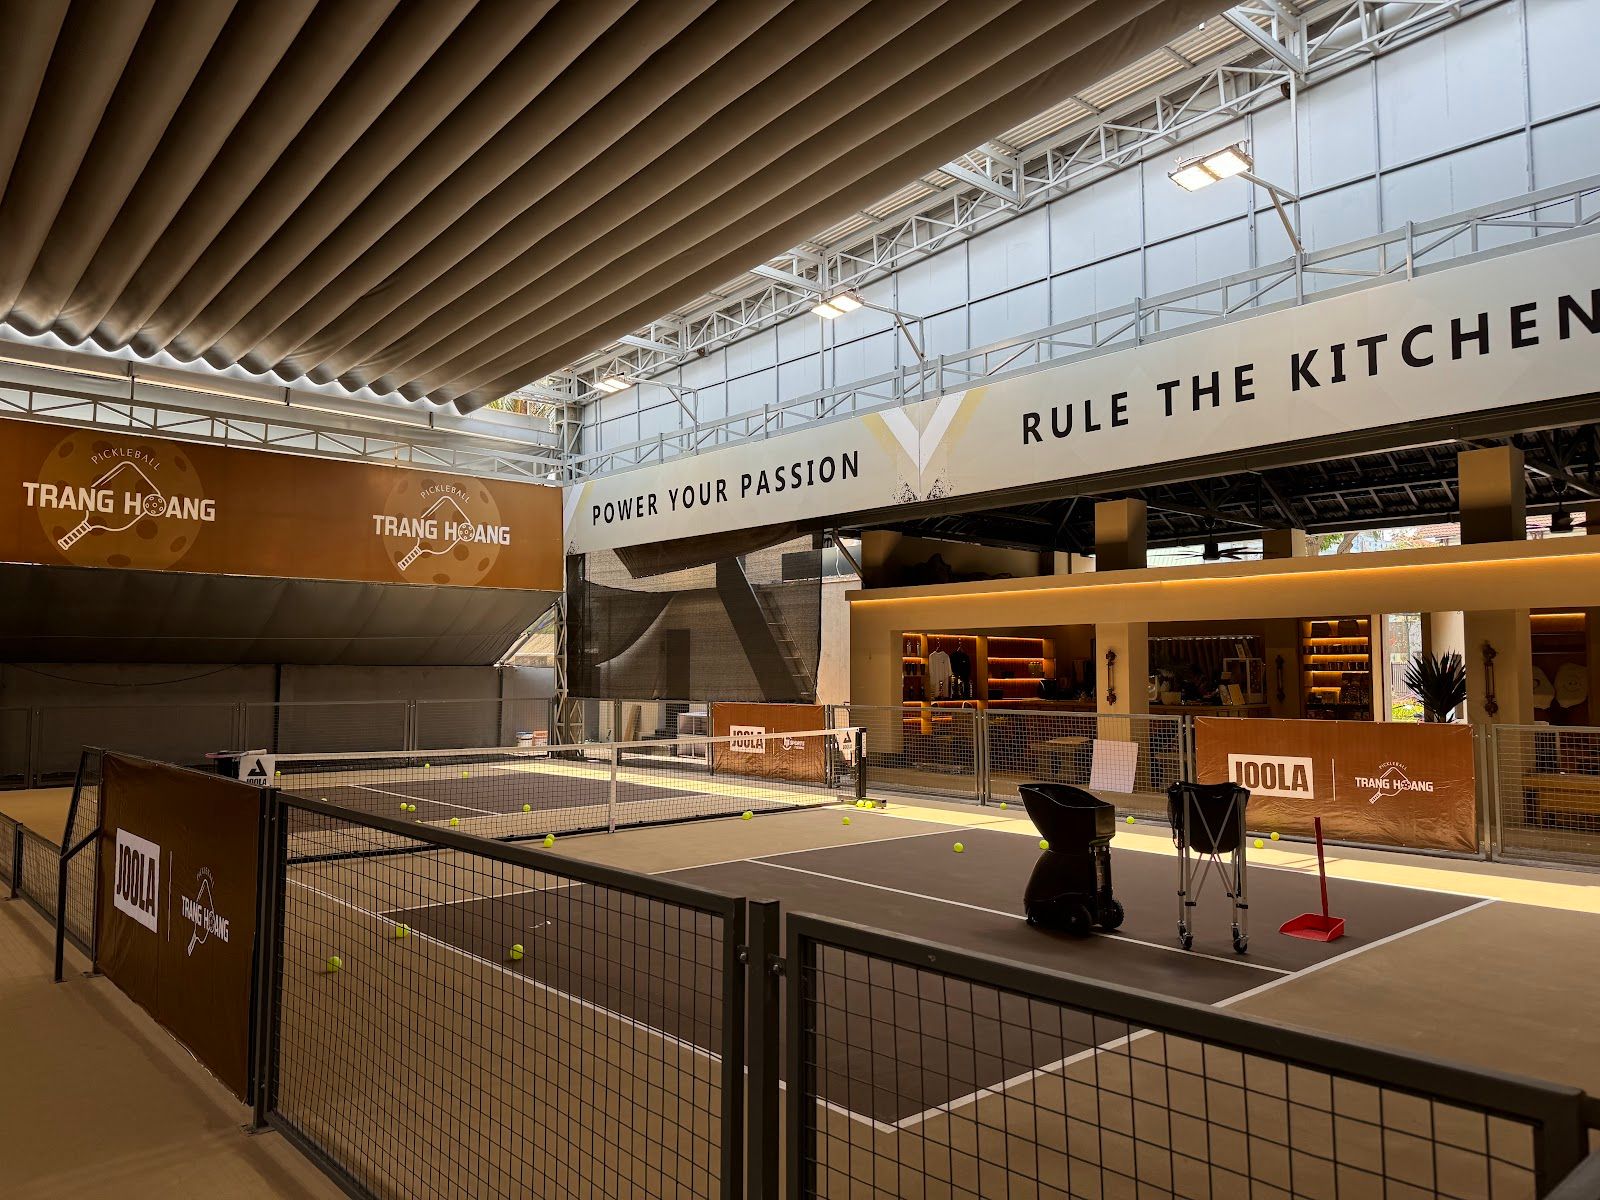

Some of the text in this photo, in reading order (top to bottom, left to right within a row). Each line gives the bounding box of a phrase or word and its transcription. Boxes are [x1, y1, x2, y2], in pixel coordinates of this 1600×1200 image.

[1023, 288, 1600, 445] RULE THE KITCHEN
[91, 447, 160, 471] PICKLEBALL
[22, 481, 216, 522] TRANG HOANG
[420, 484, 470, 504] PICKLEBALL
[592, 450, 859, 526] POWER YOUR PASSION
[372, 514, 511, 546] TRANG HOANG
[1235, 761, 1309, 792] JOOLA
[1354, 776, 1390, 790] TRANG
[116, 843, 156, 918] JOOLA
[181, 894, 203, 927] TRANG
